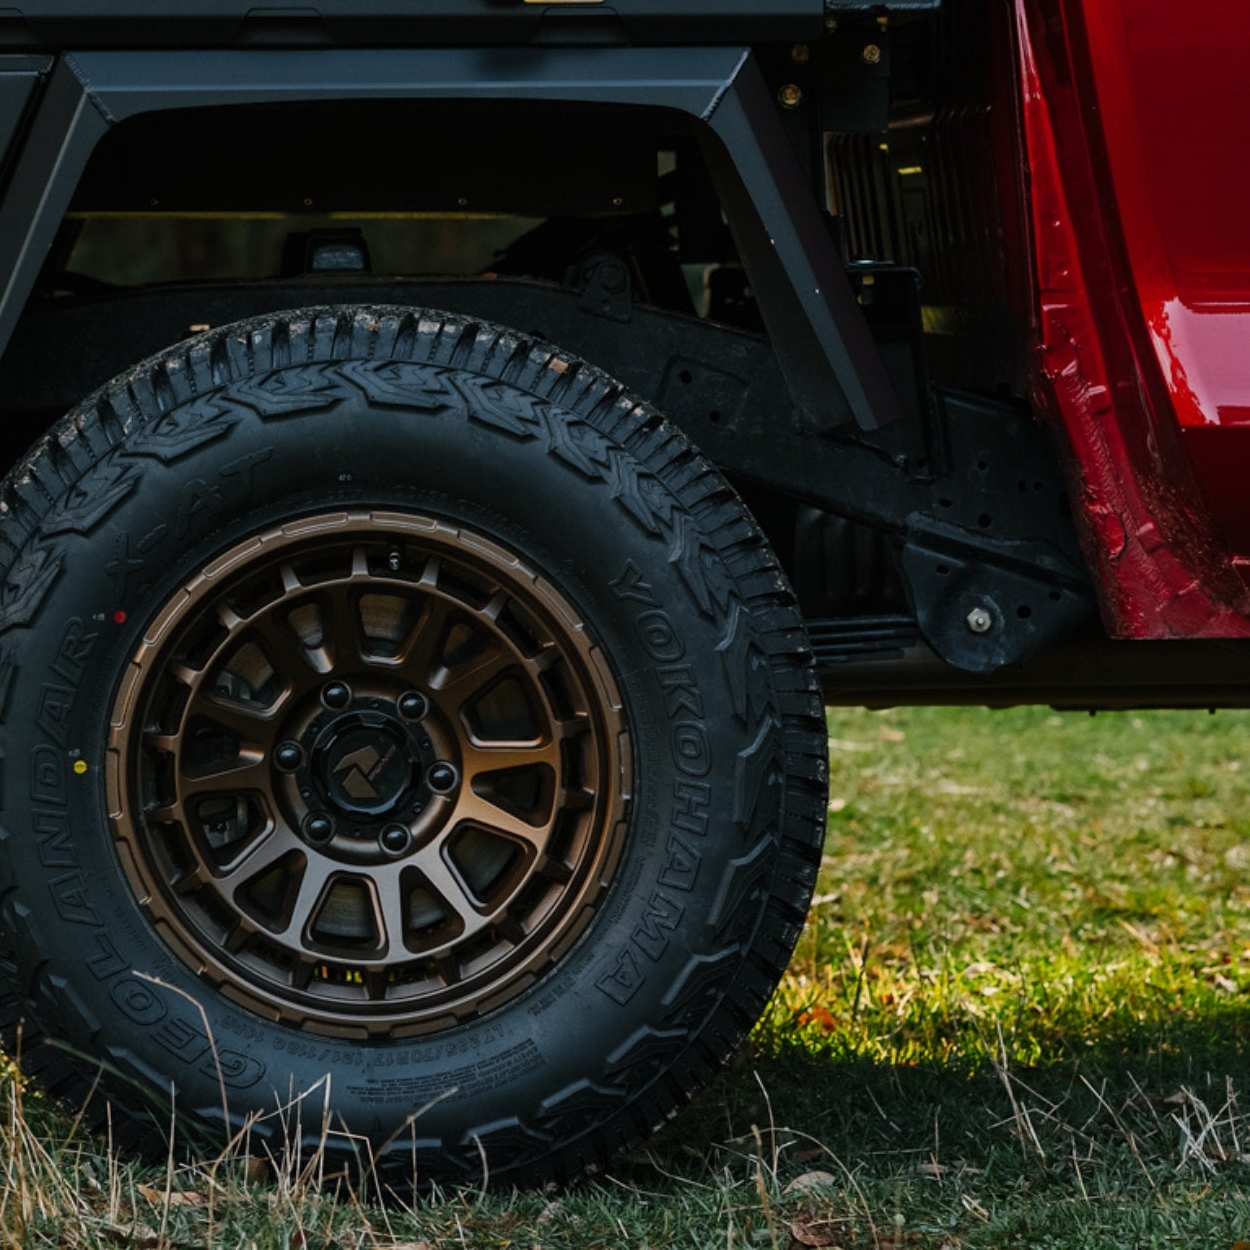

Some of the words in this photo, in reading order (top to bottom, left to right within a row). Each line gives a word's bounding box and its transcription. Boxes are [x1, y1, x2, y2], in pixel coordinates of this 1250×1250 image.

[106, 447, 275, 593] X-AT
[29, 616, 265, 1088] GEOLANDAR
[598, 561, 712, 1005] YOKOHAMA
